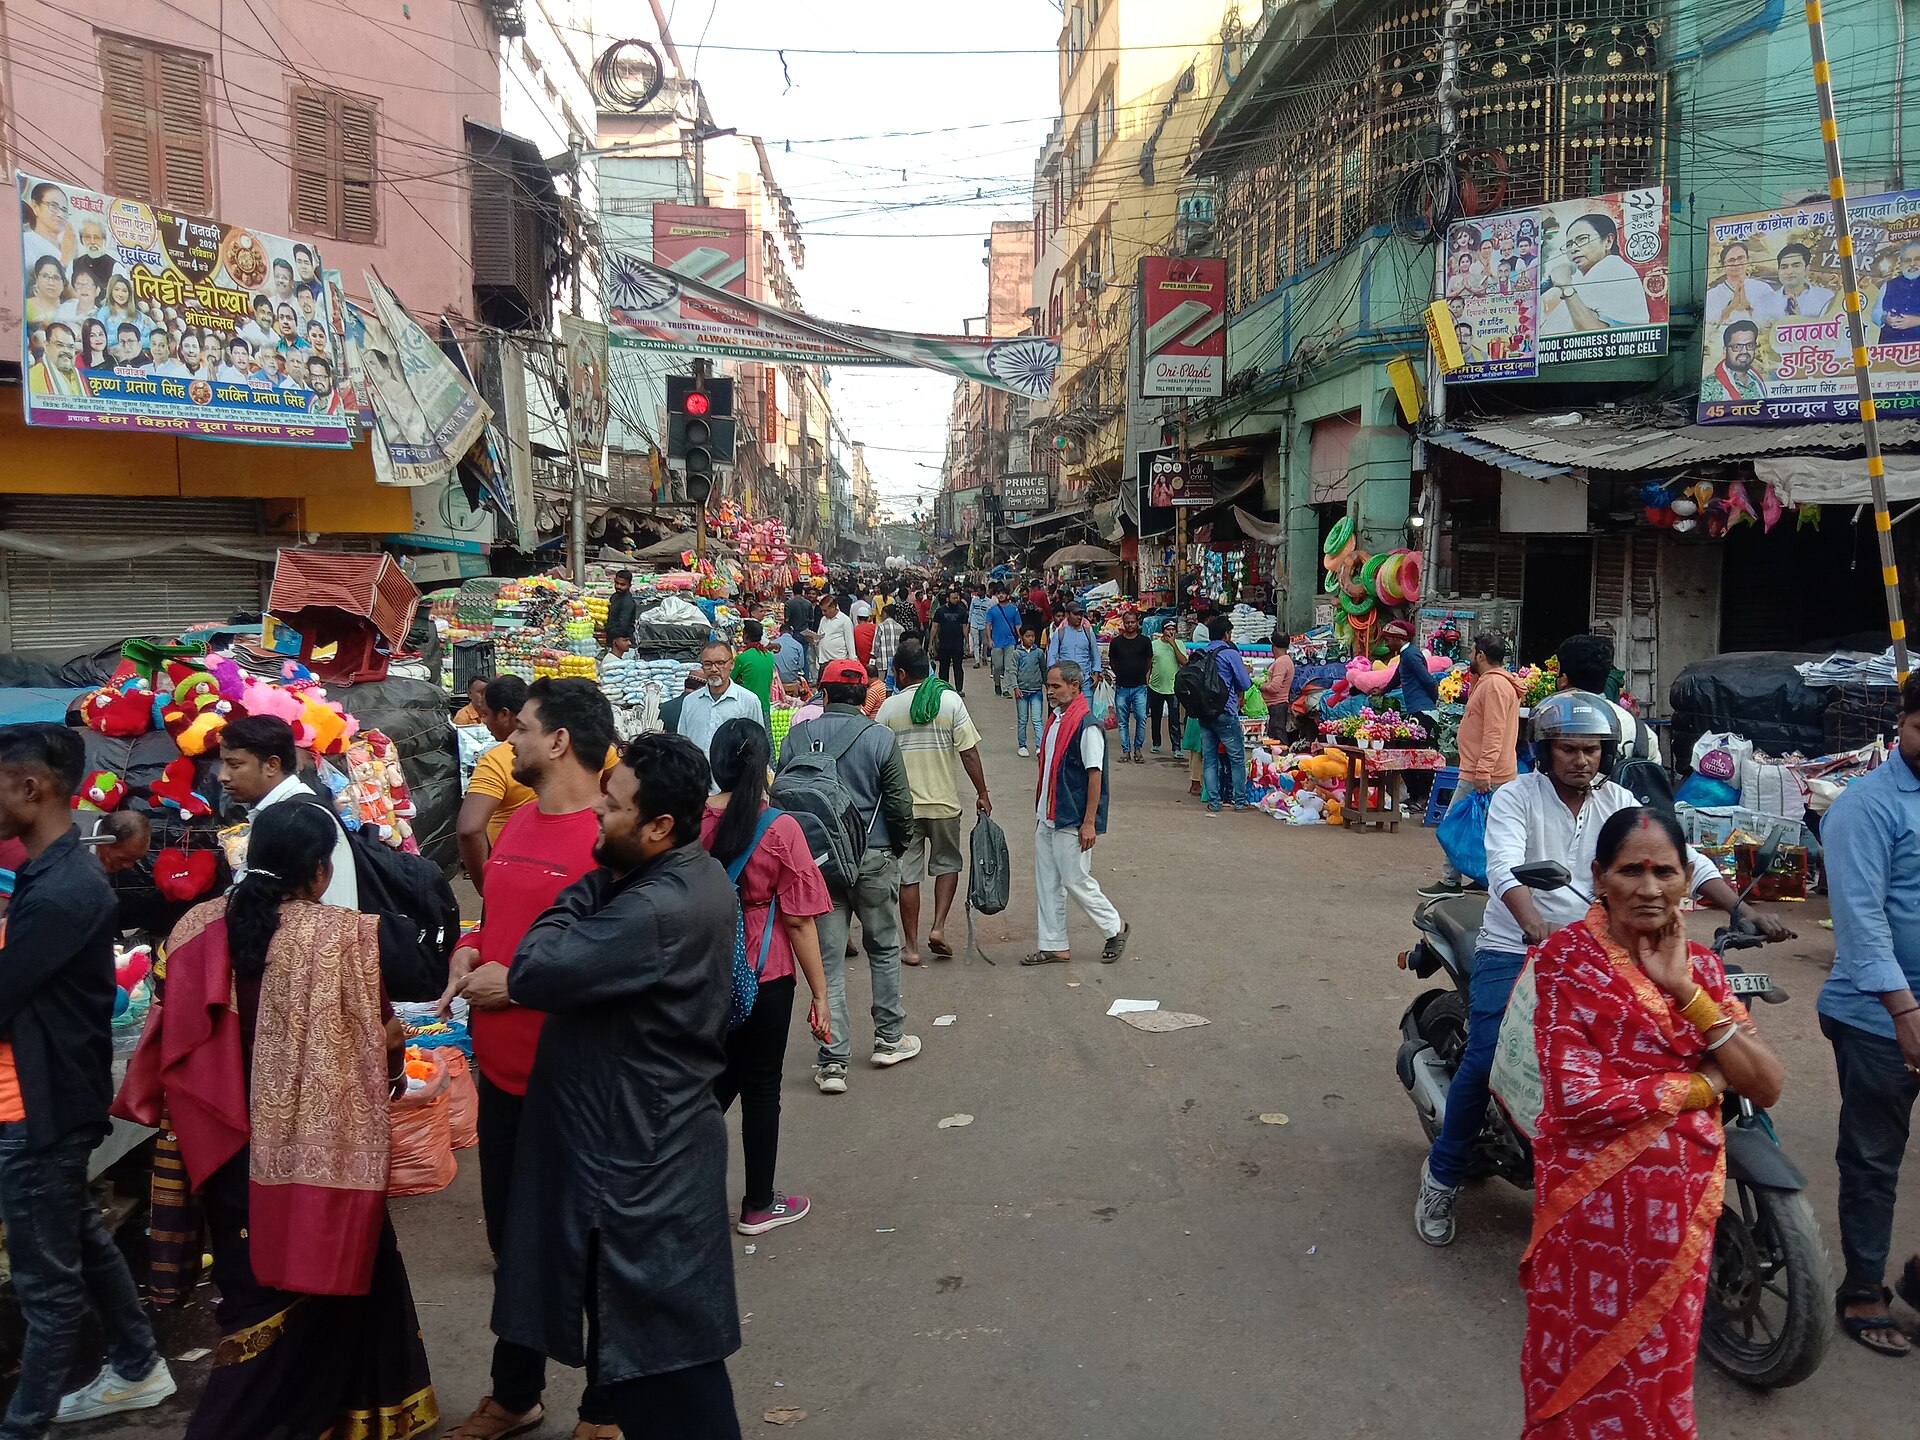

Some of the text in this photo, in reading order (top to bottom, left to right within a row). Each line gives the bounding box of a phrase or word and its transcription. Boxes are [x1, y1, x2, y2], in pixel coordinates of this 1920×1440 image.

[175, 217, 221, 246] 7 जनवरी
[1714, 222, 1753, 241] तृणमूल
[1757, 213, 1793, 231] कांग्रेस
[1797, 211, 1809, 227] के
[1812, 212, 1825, 225] 26
[1907, 218, 1919, 228] 12
[1823, 225, 1884, 241] HPPY
[199, 239, 218, 251] 2024
[192, 258, 199, 271] 4
[185, 310, 236, 331] भोजोत्सव
[667, 321, 700, 331] TRUSTED
[702, 325, 722, 333] SHOP
[747, 329, 765, 337] TYPE
[1776, 315, 1845, 343] नववर्ष
[697, 334, 739, 345] ALWAYS
[741, 338, 777, 347] READY
[779, 341, 793, 349] TO
[796, 343, 821, 352] GIVE
[1563, 335, 1608, 349] CONGRESS
[1610, 329, 1661, 344] COMMITTEE
[640, 341, 685, 350] CANNING
[688, 344, 726, 353] STREET
[728, 348, 762, 357] (NEAR
[786, 352, 814, 360] SHAW
[816, 354, 859, 363] MARKET)
[1560, 347, 1603, 361] CONGRESS
[1605, 345, 1616, 357] SC
[1618, 343, 1635, 355] OBC
[1637, 342, 1657, 354] CELL
[1157, 362, 1212, 378] Ori-Plast
[1778, 345, 1840, 378] हार्दिक
[89, 376, 186, 399] कृष्ण प्रताप सिंह
[216, 385, 249, 402] शक्ति
[253, 390, 281, 405] प्रताप
[283, 391, 306, 408] सिंह
[1770, 382, 1793, 396] शक्ति
[1795, 384, 1817, 395] प्रताप
[1820, 380, 1837, 394] सिंह
[1706, 405, 1725, 417] 45
[1731, 400, 1763, 416] वार्ड
[1766, 401, 1828, 419] तृणमूल
[97, 413, 129, 426] बंग
[136, 415, 190, 429] बिहारी
[233, 424, 281, 436] समाज
[1005, 477, 1045, 488] PRINCE
[1005, 487, 1047, 497] PLASTICS
[426, 536, 454, 547] TRADING
[1710, 758, 1726, 769] mio
